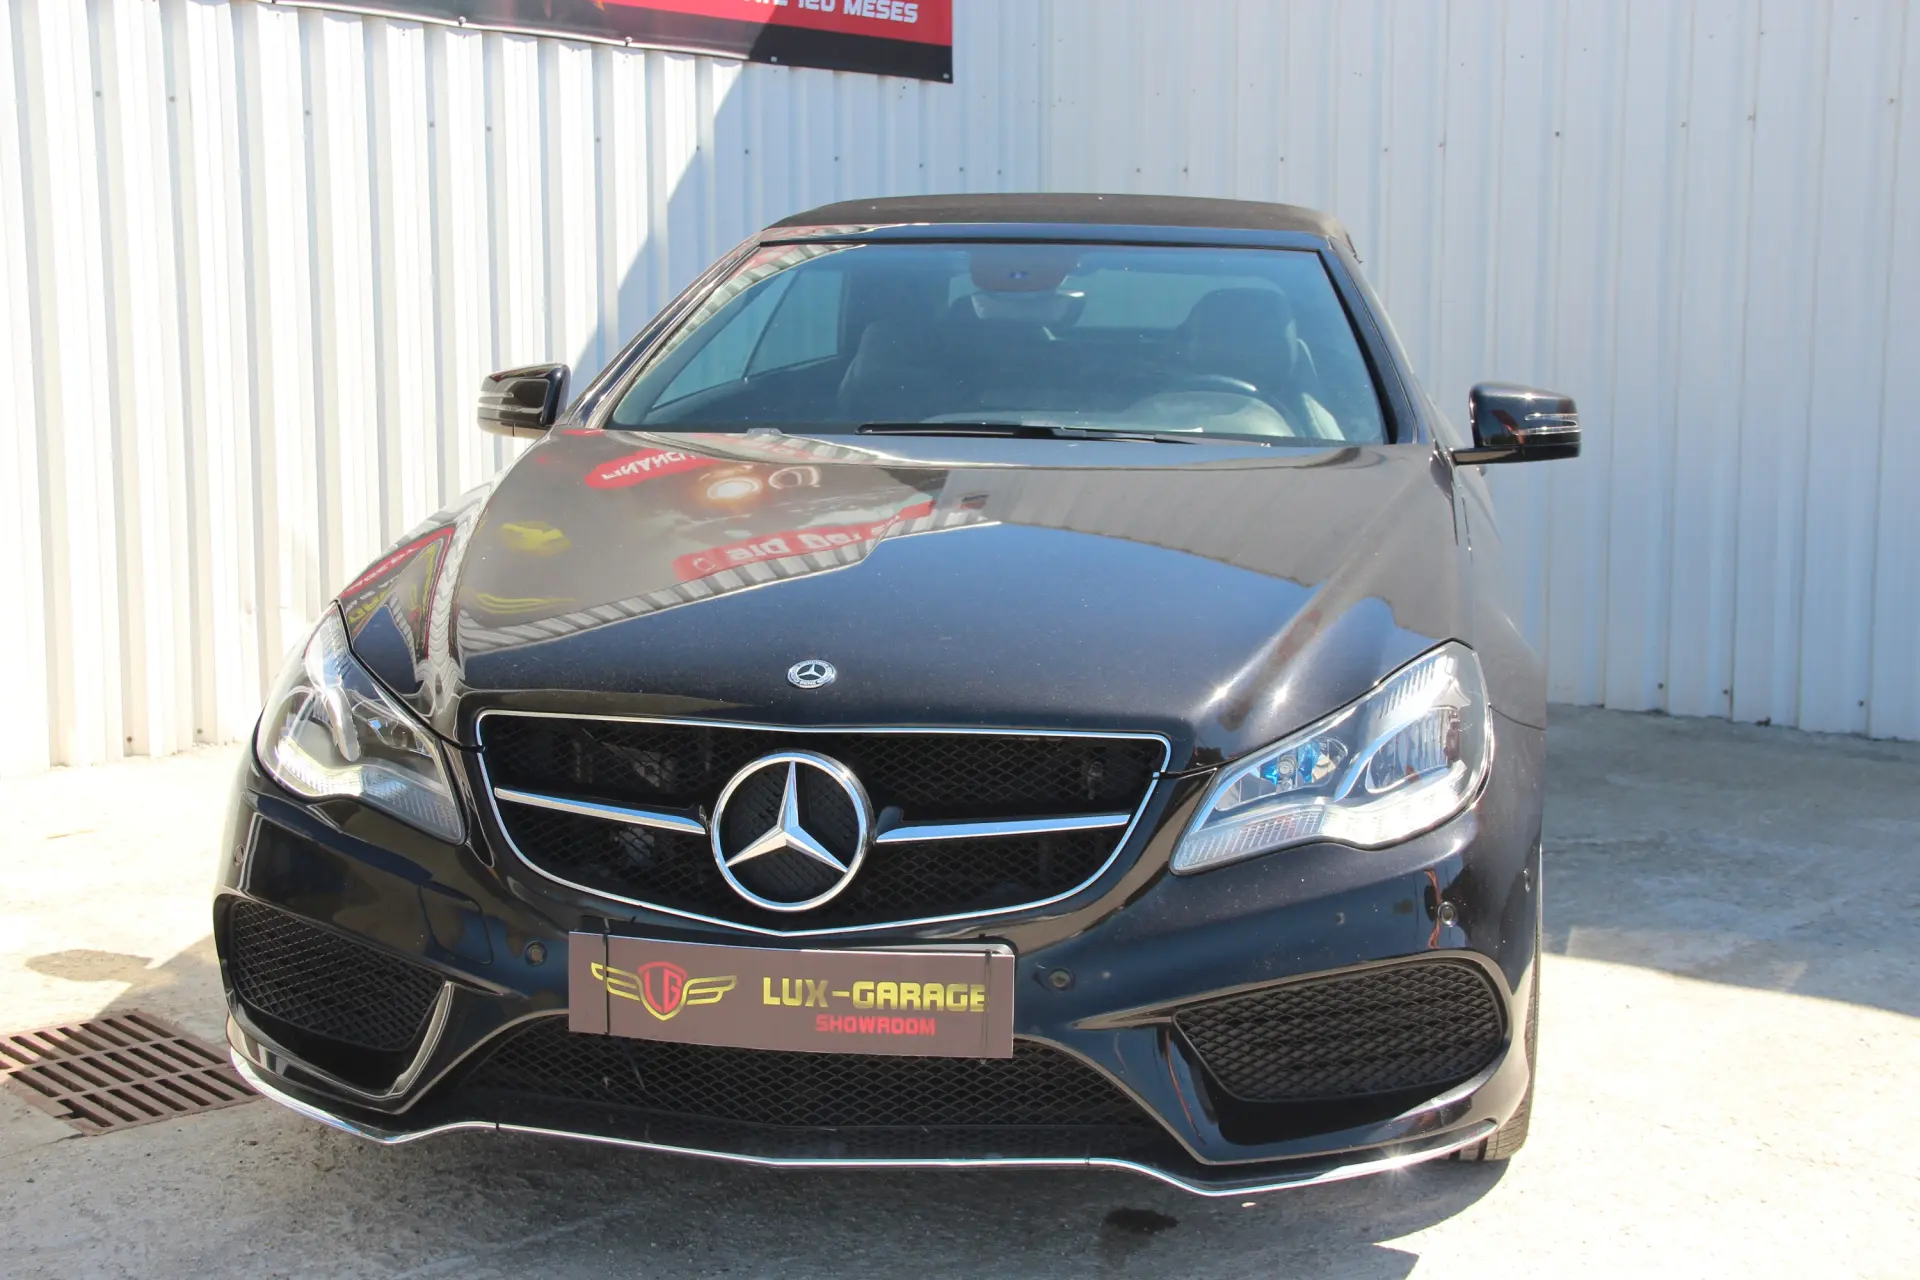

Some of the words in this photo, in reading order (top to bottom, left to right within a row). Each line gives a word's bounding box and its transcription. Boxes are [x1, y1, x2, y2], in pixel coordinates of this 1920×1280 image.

[843, 0, 919, 24] MESES
[763, 977, 986, 1012] LUX-GARAGE
[815, 1014, 936, 1036] SHOWROOM
